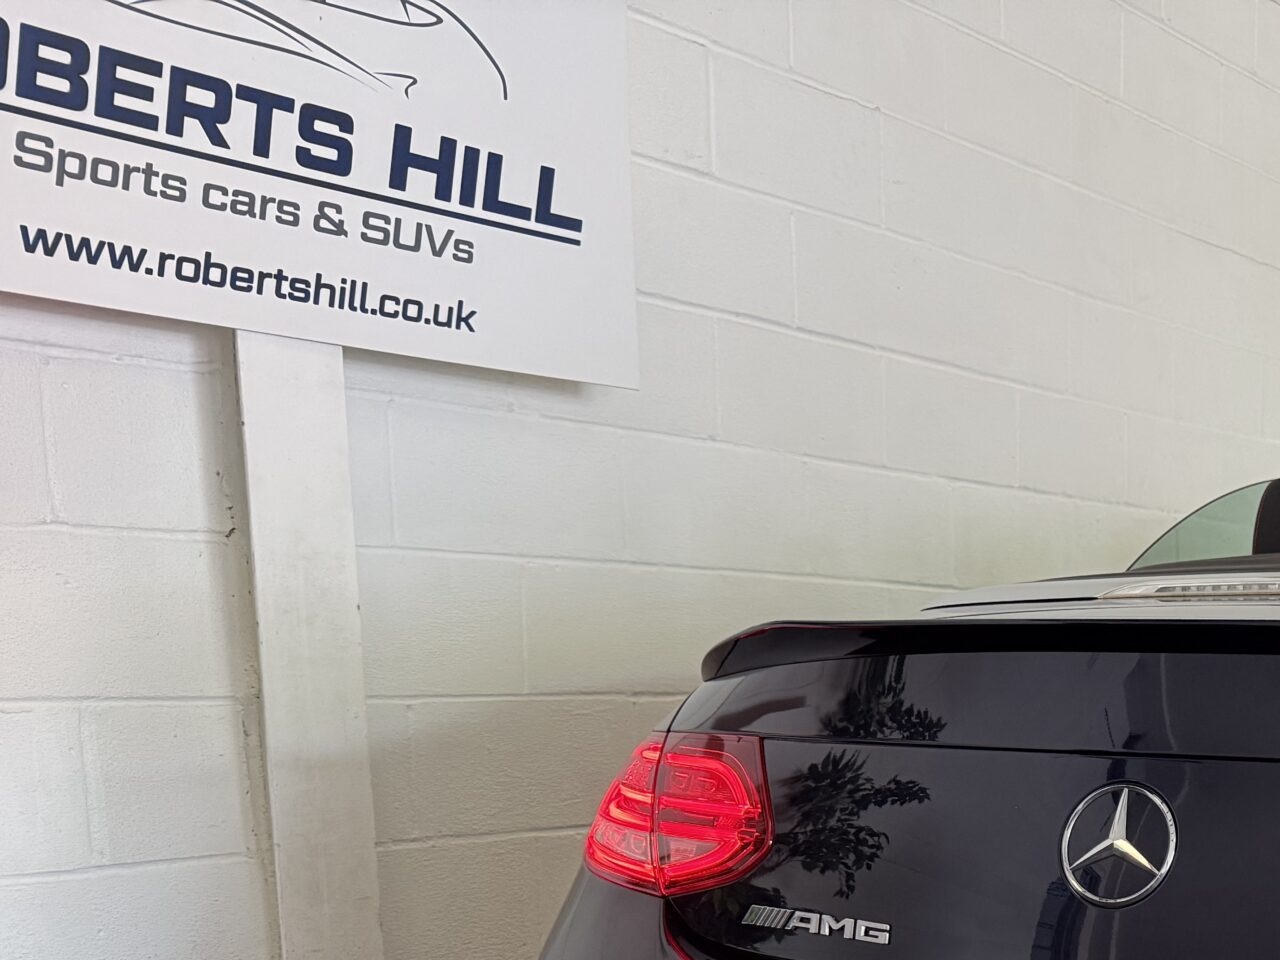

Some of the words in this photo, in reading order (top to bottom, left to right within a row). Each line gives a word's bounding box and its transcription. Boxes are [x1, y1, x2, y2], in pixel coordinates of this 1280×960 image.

[0, 17, 354, 177] BERTS
[388, 123, 582, 233] HILL
[13, 130, 187, 202] Sports
[201, 181, 300, 227] cars
[313, 202, 348, 238] &
[360, 211, 475, 264] SUVs
[19, 224, 477, 333] www.robertshill.co.uk
[785, 910, 891, 944] AMG
